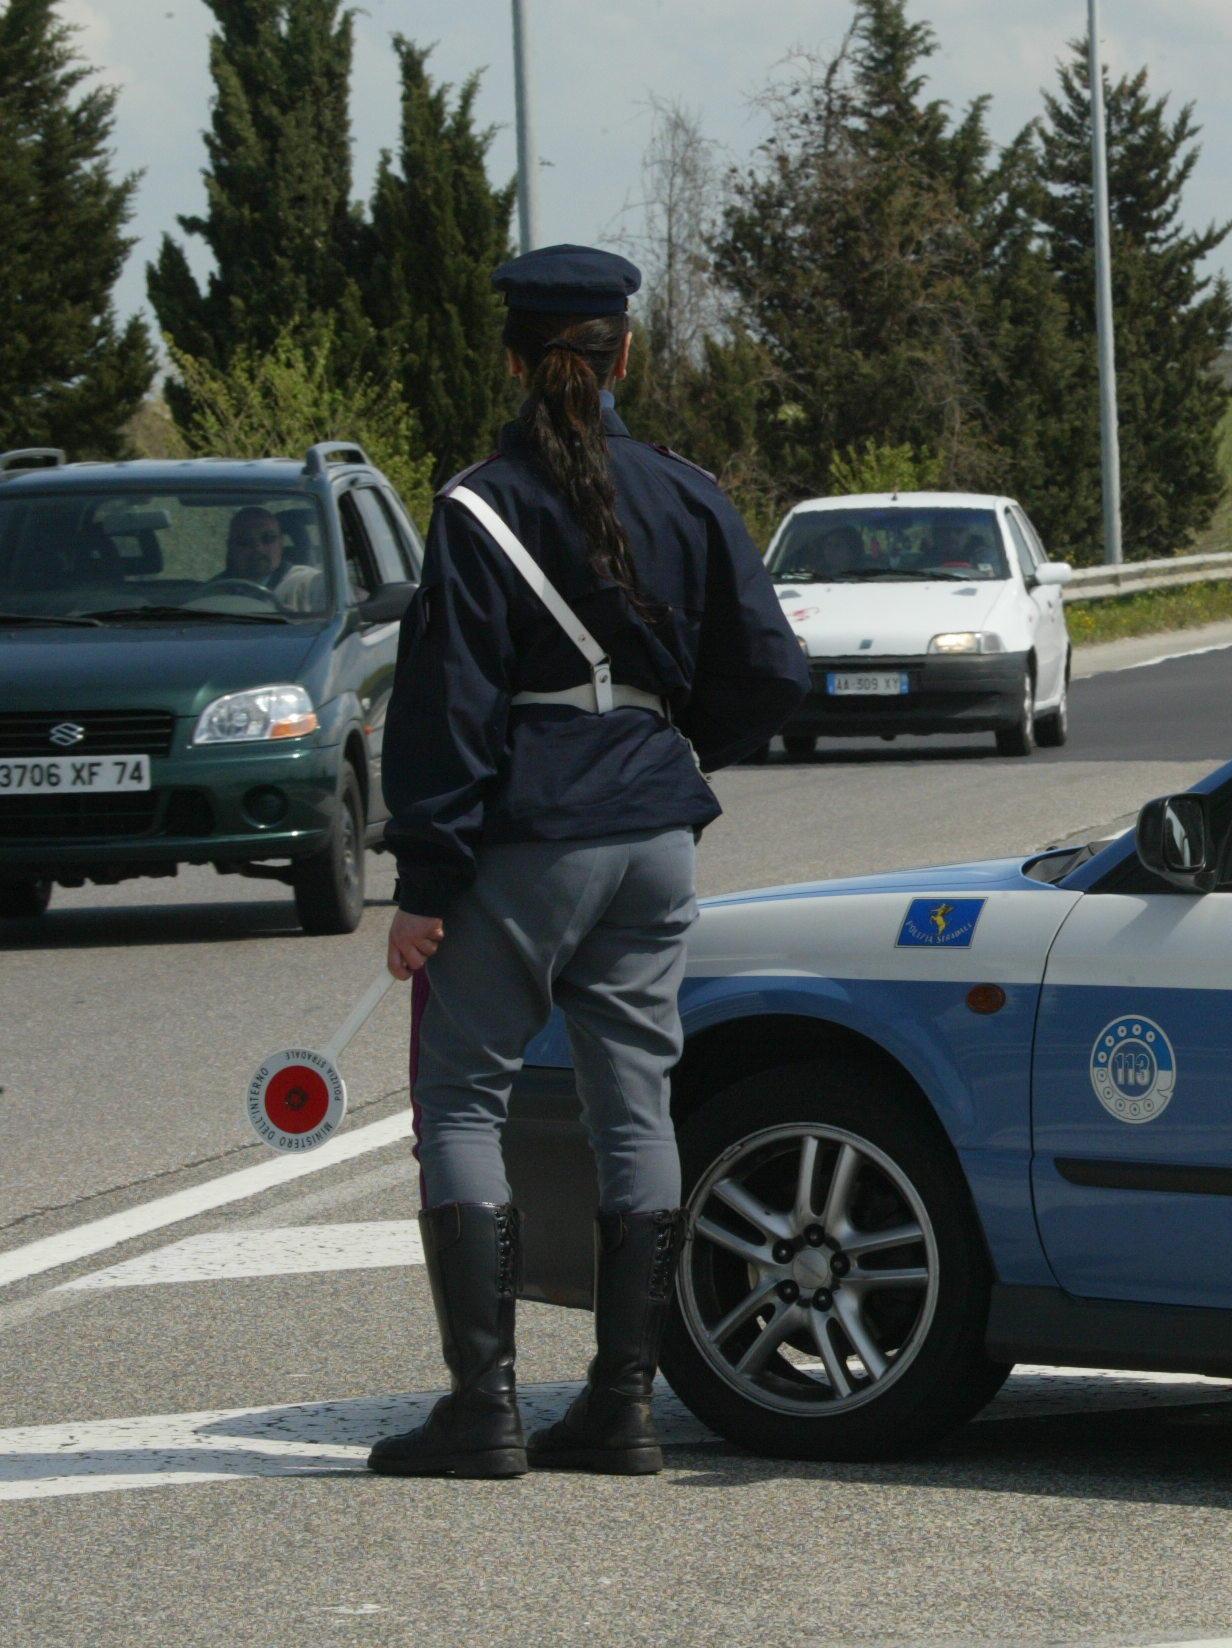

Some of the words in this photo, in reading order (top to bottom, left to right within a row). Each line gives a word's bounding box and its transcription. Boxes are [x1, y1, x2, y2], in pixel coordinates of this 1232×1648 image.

[0, 763, 61, 788] 3706
[71, 762, 102, 786] XF
[112, 760, 143, 785] 74
[286, 1050, 327, 1069] STRADALE
[1114, 1052, 1150, 1086] 113
[326, 1067, 343, 1101] POLIZIA
[279, 1121, 333, 1149] MINISTERO
